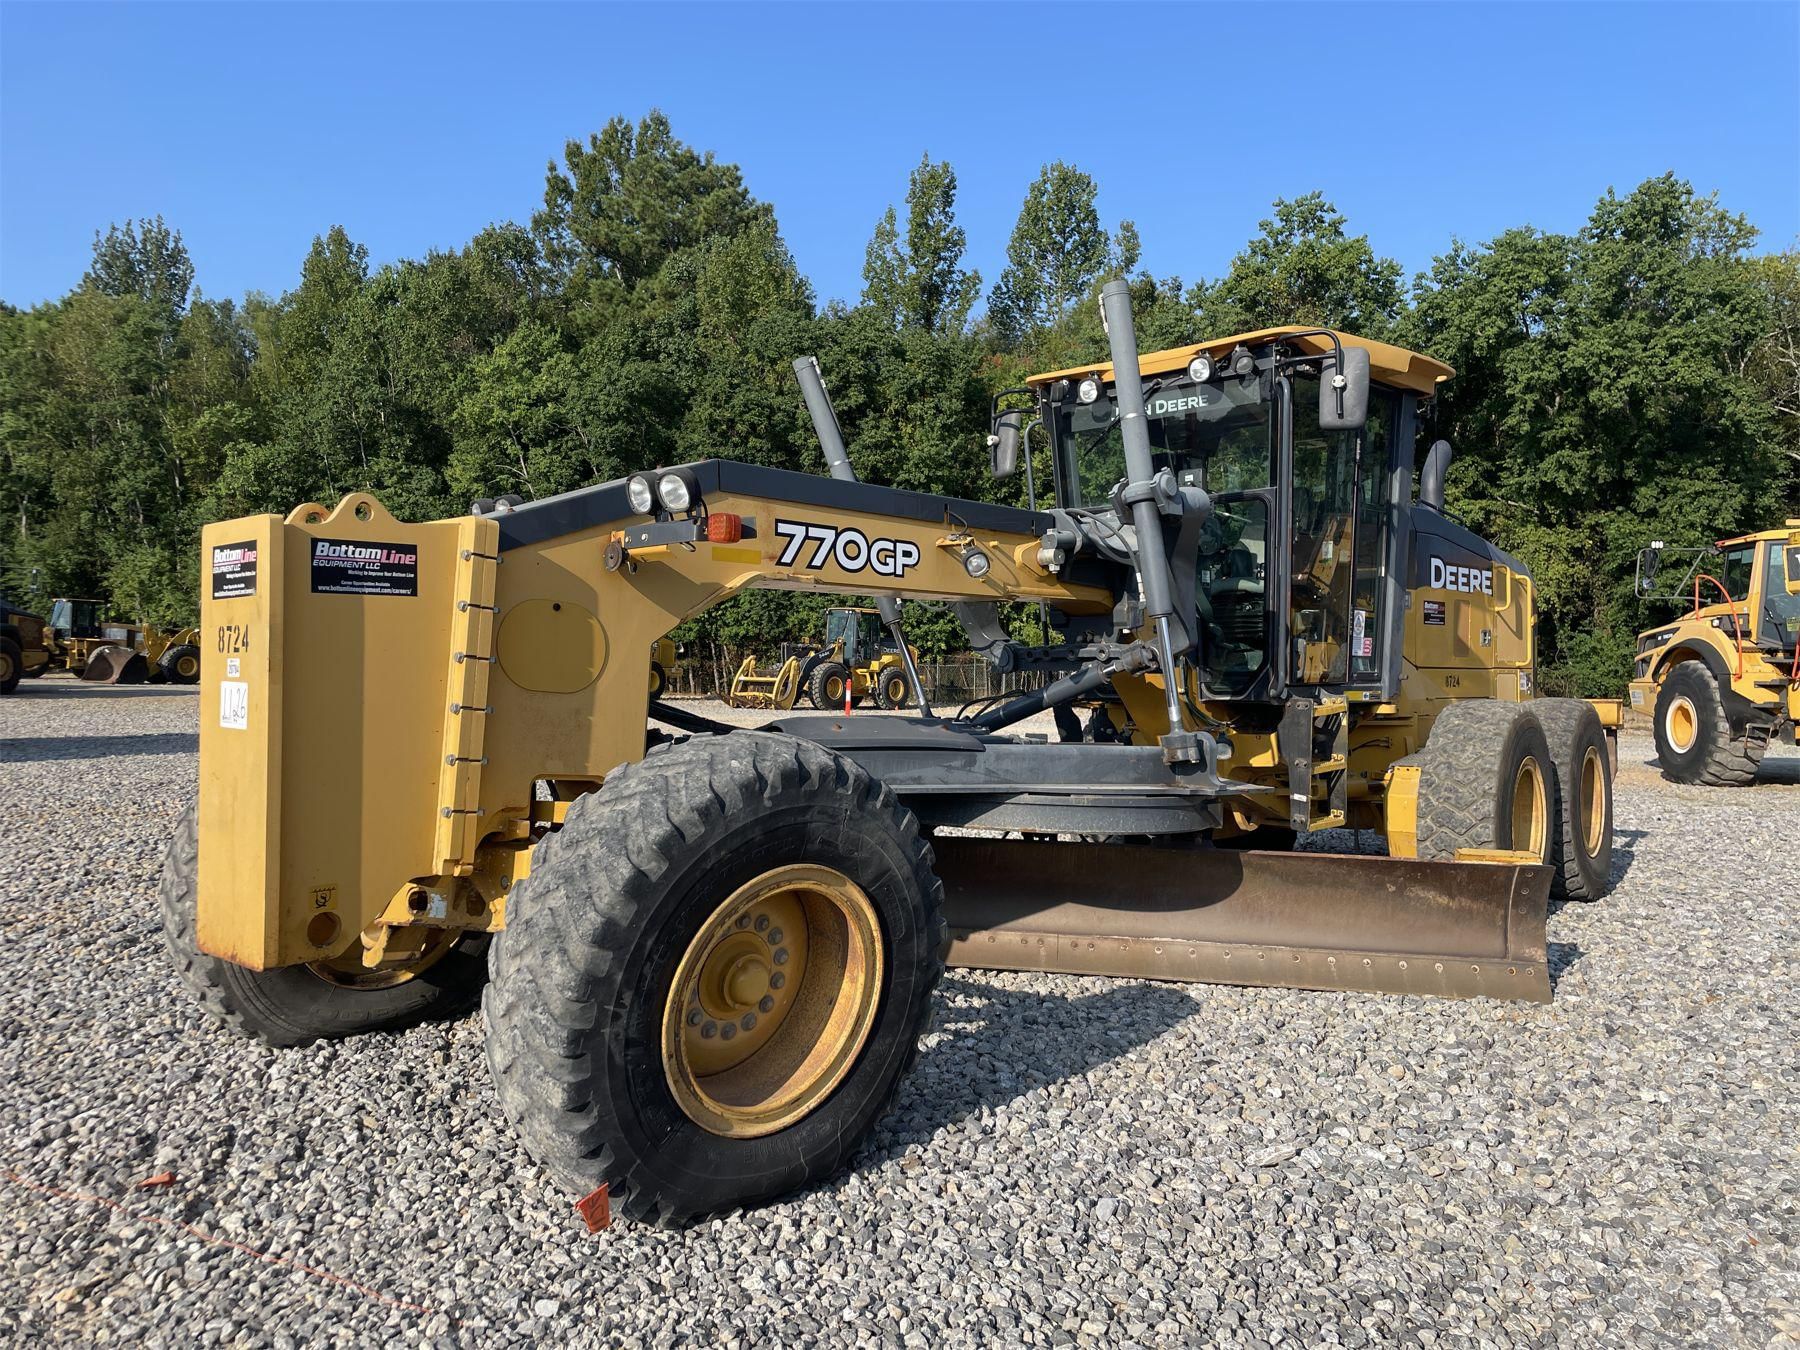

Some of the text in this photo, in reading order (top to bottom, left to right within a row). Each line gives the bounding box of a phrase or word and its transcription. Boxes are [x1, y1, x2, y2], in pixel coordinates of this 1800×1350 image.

[1155, 395, 1209, 414] DEERE
[214, 548, 257, 564] BottomLine
[315, 541, 416, 565] BottomLine
[776, 520, 919, 577] 770GP
[312, 559, 381, 570] EQUIPMENT LLC
[1430, 557, 1492, 596] DEERE
[218, 624, 249, 654] 8724
[1445, 674, 1460, 688] 8724
